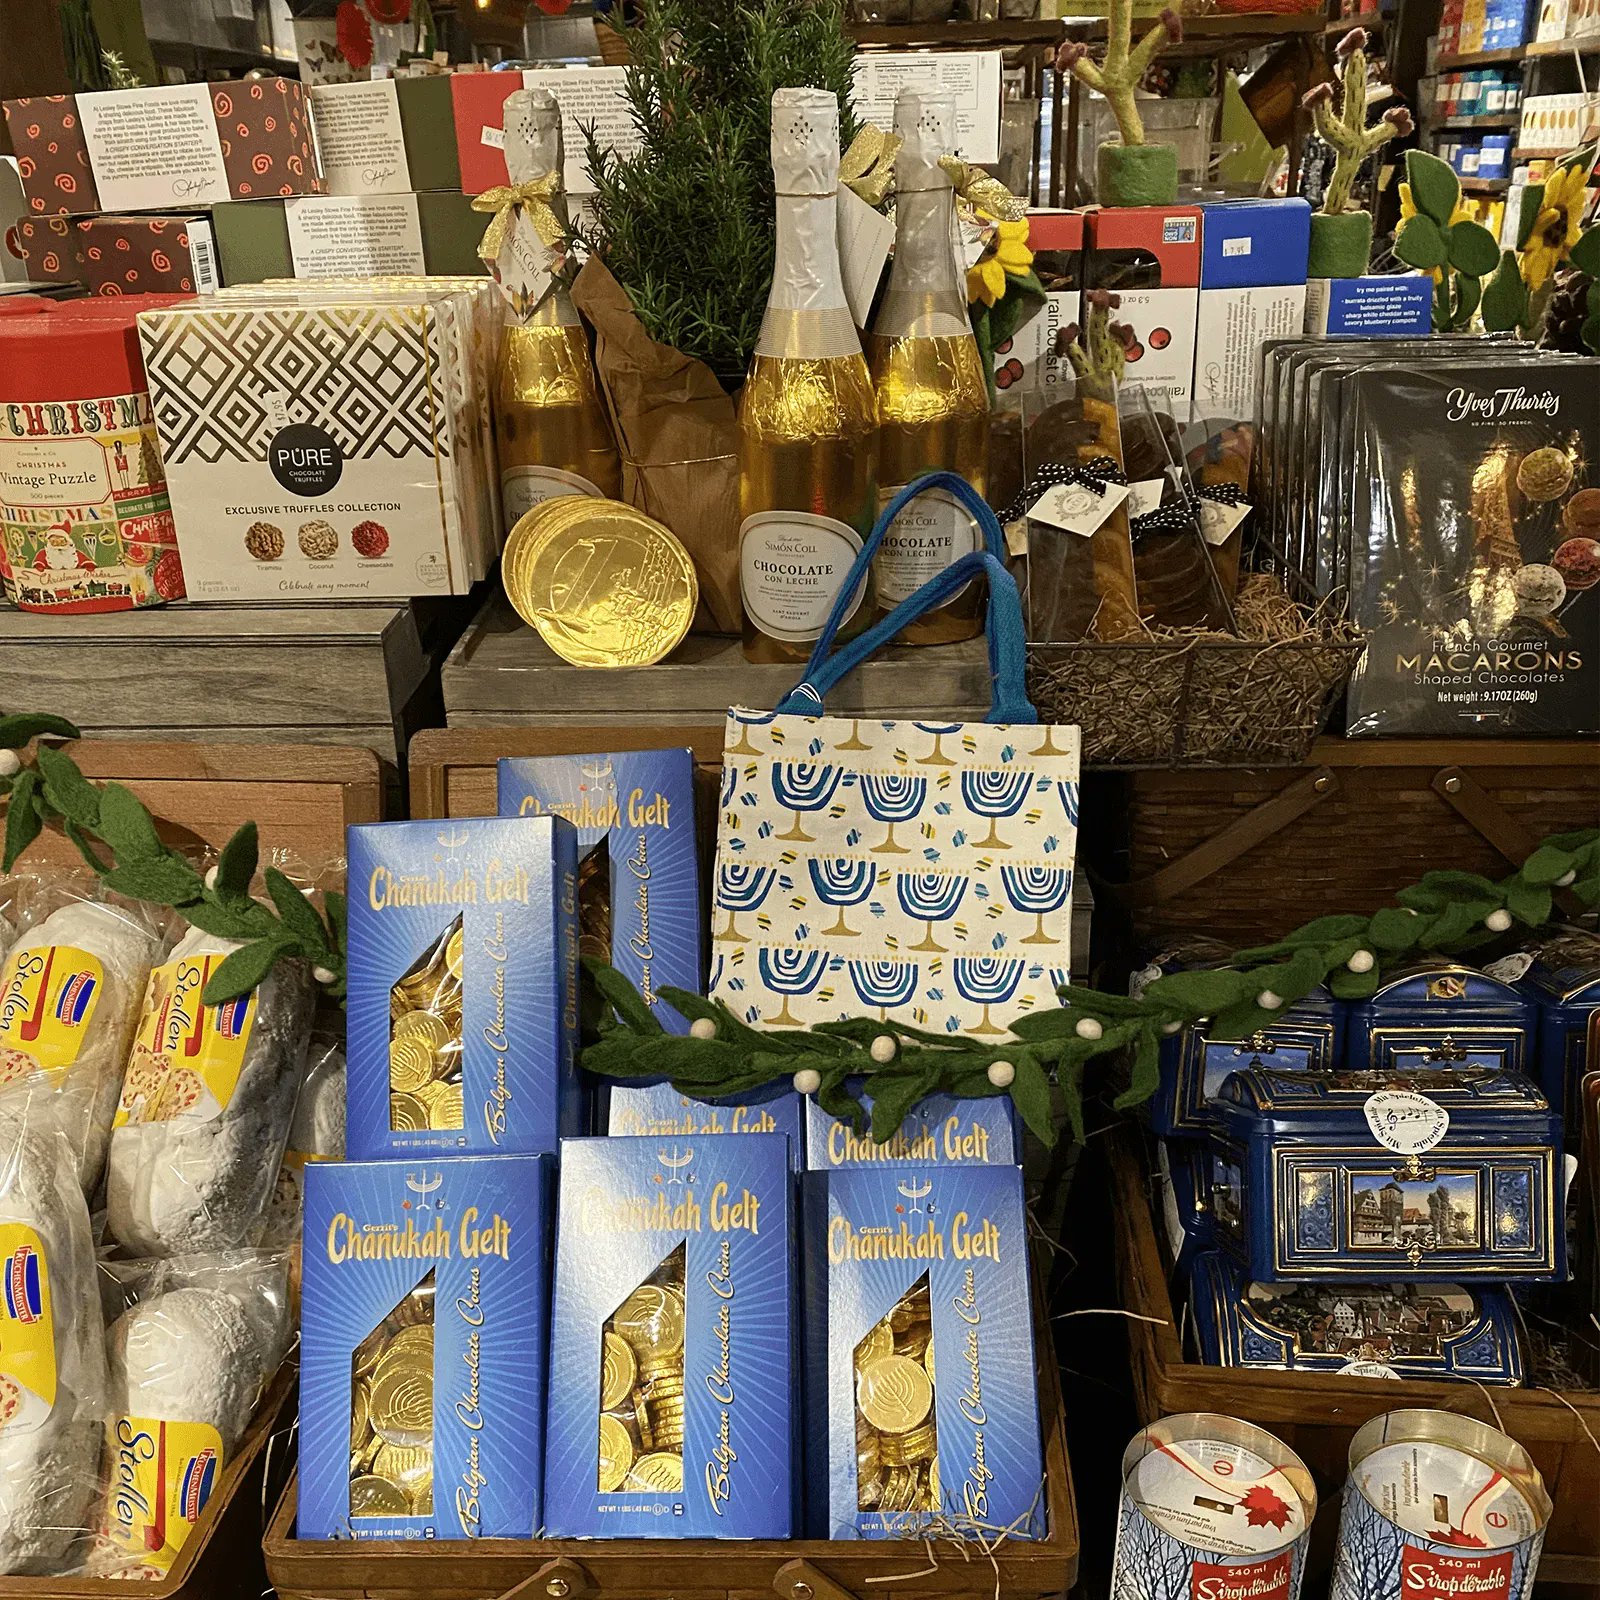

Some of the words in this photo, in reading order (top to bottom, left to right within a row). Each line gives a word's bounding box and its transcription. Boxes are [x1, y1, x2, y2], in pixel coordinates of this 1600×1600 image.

[272, 399, 288, 420] $7.95
[1446, 387, 1496, 422] Yves
[0, 472, 45, 488] Vintage
[48, 471, 97, 485] Puzzle
[289, 469, 326, 477] CHOCOLATE
[114, 490, 146, 499] MERRY
[225, 506, 280, 515] EXCLUSIVE
[283, 504, 335, 513] TRUFFLES
[337, 502, 401, 512] COLLECTION
[916, 516, 938, 526] COLL
[765, 540, 793, 552] SIMÓN
[795, 543, 817, 553] COLL
[880, 536, 952, 548] HOCOLATE
[754, 560, 834, 576] CHOCOLATE
[764, 575, 782, 583] CON
[279, 580, 313, 591] Celebrate
[317, 583, 334, 593] any
[337, 581, 369, 589] moment
[1395, 650, 1583, 673] MACARONS
[1432, 640, 1480, 652] French
[1487, 640, 1549, 651] Gourmet
[1415, 672, 1472, 686] Shaped
[1478, 671, 1565, 684] Chocolates
[1437, 691, 1451, 702] Net
[1453, 691, 1478, 704] weight
[628, 788, 670, 829] Gelt
[627, 833, 651, 880] Coins
[369, 866, 477, 912] Chanukah
[486, 858, 530, 905] Gelt
[561, 872, 576, 915] Gelt
[483, 912, 508, 962] Coins
[629, 883, 653, 960] Chocolate
[0, 952, 43, 1030] Stollen
[563, 923, 577, 1029] Chanukah
[166, 962, 200, 1050] Stollen
[482, 966, 509, 1052] Chocolate
[484, 1058, 512, 1146] Belgian
[1374, 1094, 1389, 1104] Mit
[1389, 1093, 1429, 1106] Spieluhr
[943, 1116, 990, 1164] Gelt
[1386, 1136, 1402, 1149] Mit
[1412, 1122, 1445, 1150] Spieluhr
[578, 1186, 702, 1235] Chanukah
[710, 1182, 761, 1235] Gelt
[327, 1212, 451, 1265] Chanukah
[459, 1207, 512, 1261] Gelt
[362, 1223, 399, 1234] Gerrit's
[828, 1215, 945, 1265] Chanukah
[951, 1211, 1001, 1264] Gelt
[860, 1224, 893, 1235] Gerrit's
[14, 1252, 28, 1320] KUCHENMEISTER
[706, 1238, 733, 1300] Coins
[455, 1266, 486, 1328] Coins
[952, 1266, 982, 1326] Coins
[705, 1302, 735, 1404] Chocolate
[455, 1330, 485, 1432] Chocolate
[958, 1329, 989, 1426] Chocolate
[117, 1419, 155, 1540] Stollen
[704, 1409, 730, 1516] Belgian
[963, 1430, 990, 1524] Belgian
[188, 1453, 208, 1521] KUCHENMEISTER
[455, 1435, 488, 1540] Belgian
[1178, 1517, 1204, 1530] parfum
[1204, 1523, 1216, 1533] Vrai
[1189, 1536, 1208, 1547] Scent
[1208, 1540, 1230, 1552] Syrup
[1228, 1568, 1250, 1577] 540
[1253, 1567, 1267, 1575] ml
[1406, 1563, 1460, 1596] Sirop
[1459, 1567, 1506, 1593] d'érable
[1438, 1558, 1463, 1568] 540
[1197, 1577, 1247, 1600] Sirop
